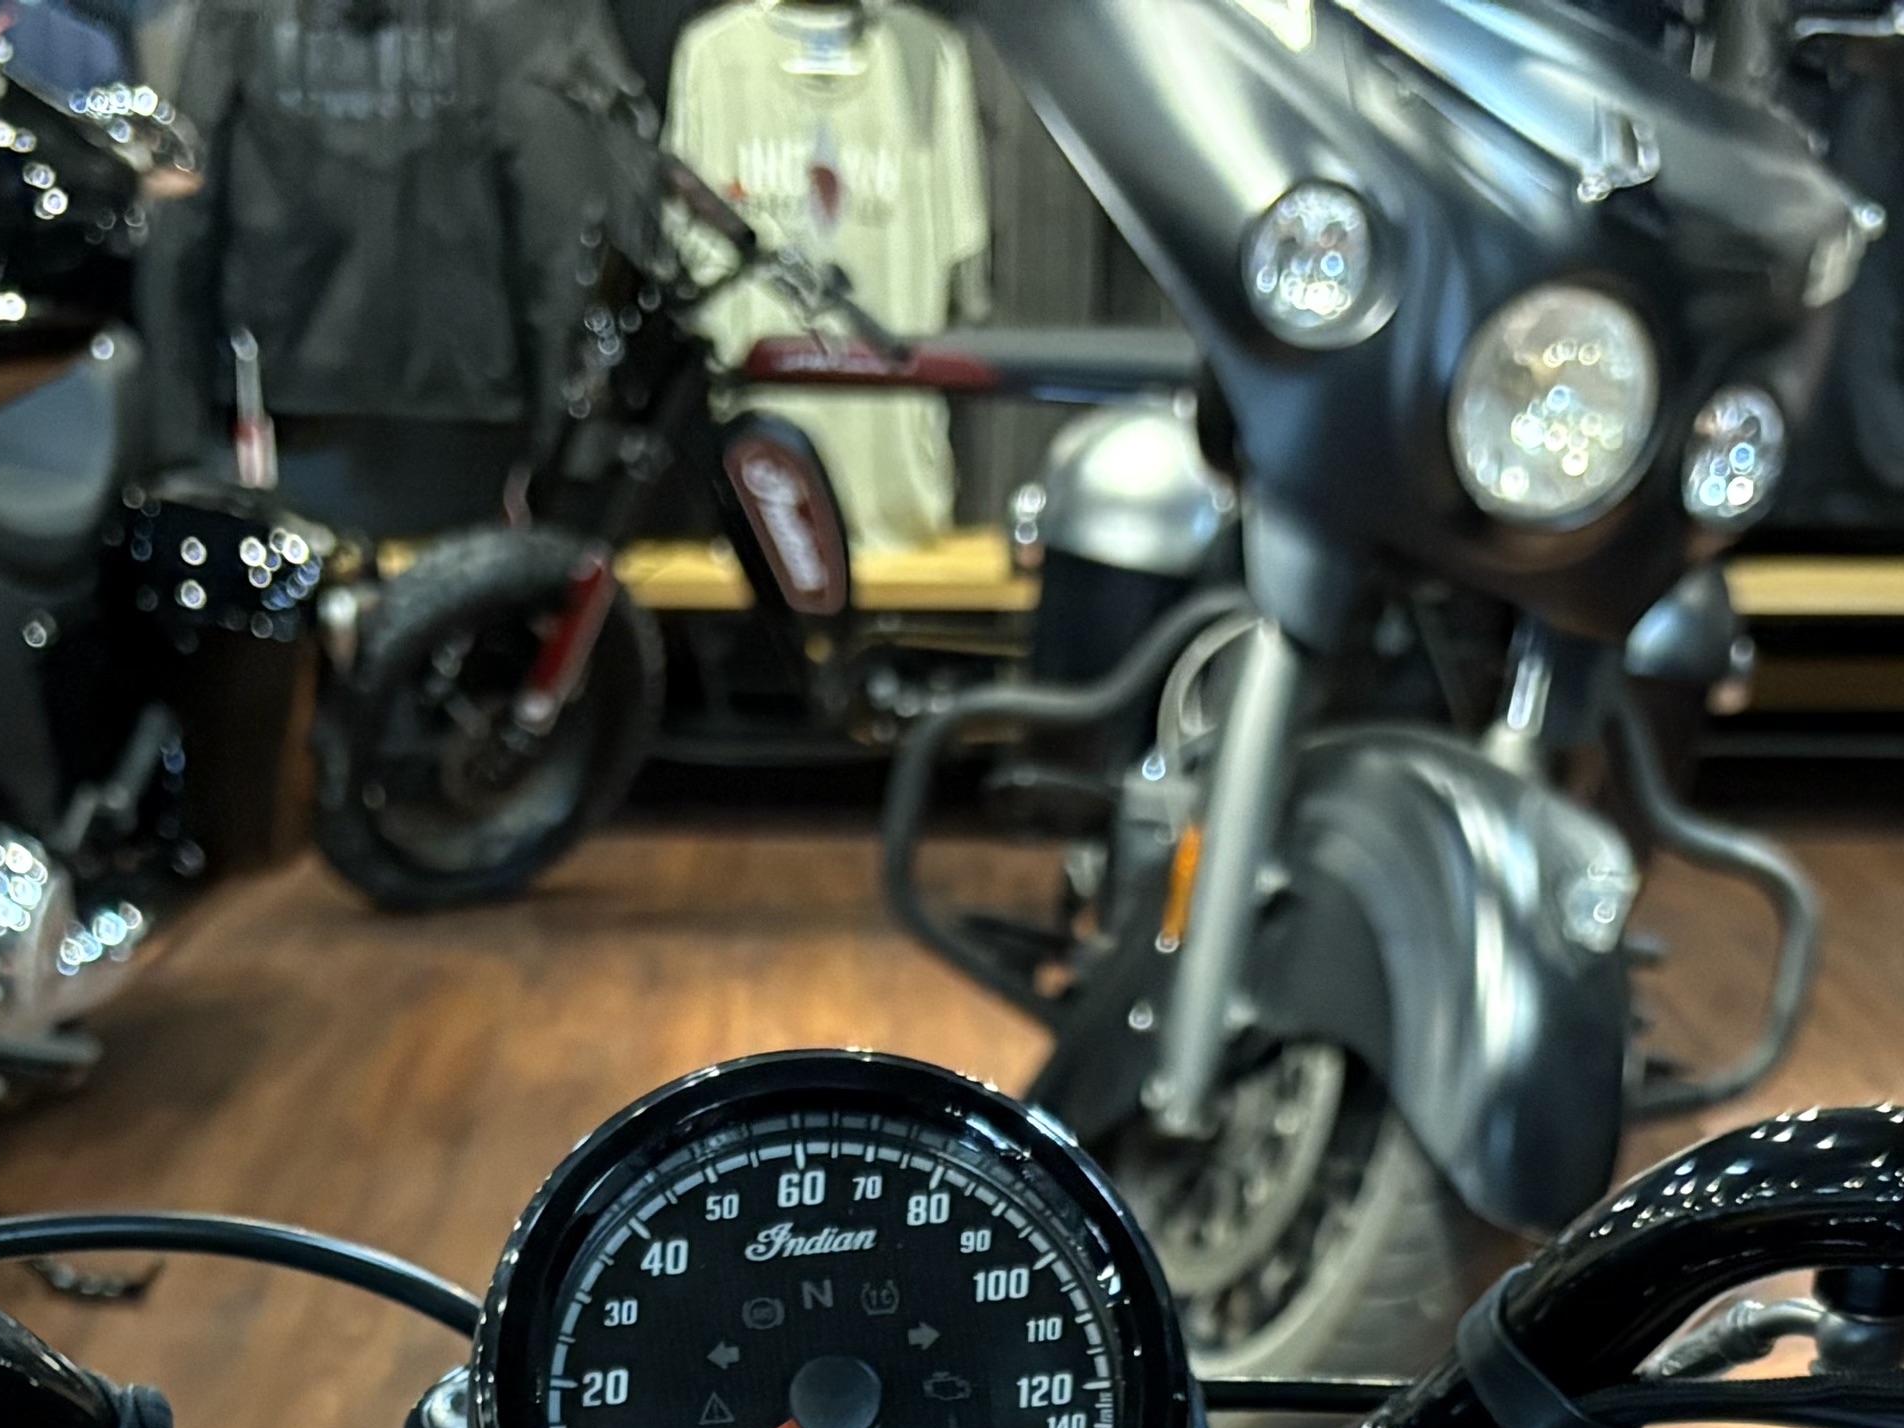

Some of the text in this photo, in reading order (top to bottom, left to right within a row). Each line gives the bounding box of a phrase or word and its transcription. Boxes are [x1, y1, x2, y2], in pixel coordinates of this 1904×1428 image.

[778, 1171, 825, 1207] 60
[853, 1176, 883, 1201] 70
[705, 1194, 740, 1221] 50
[907, 1195, 951, 1226] 80
[641, 1239, 689, 1276] 40
[745, 1223, 877, 1262] Indian
[960, 1230, 991, 1254] 90
[974, 1268, 1029, 1302] 100
[604, 1300, 638, 1327] 30
[1026, 1317, 1062, 1342] 110
[582, 1371, 629, 1406] 20
[1017, 1374, 1073, 1408] 120
